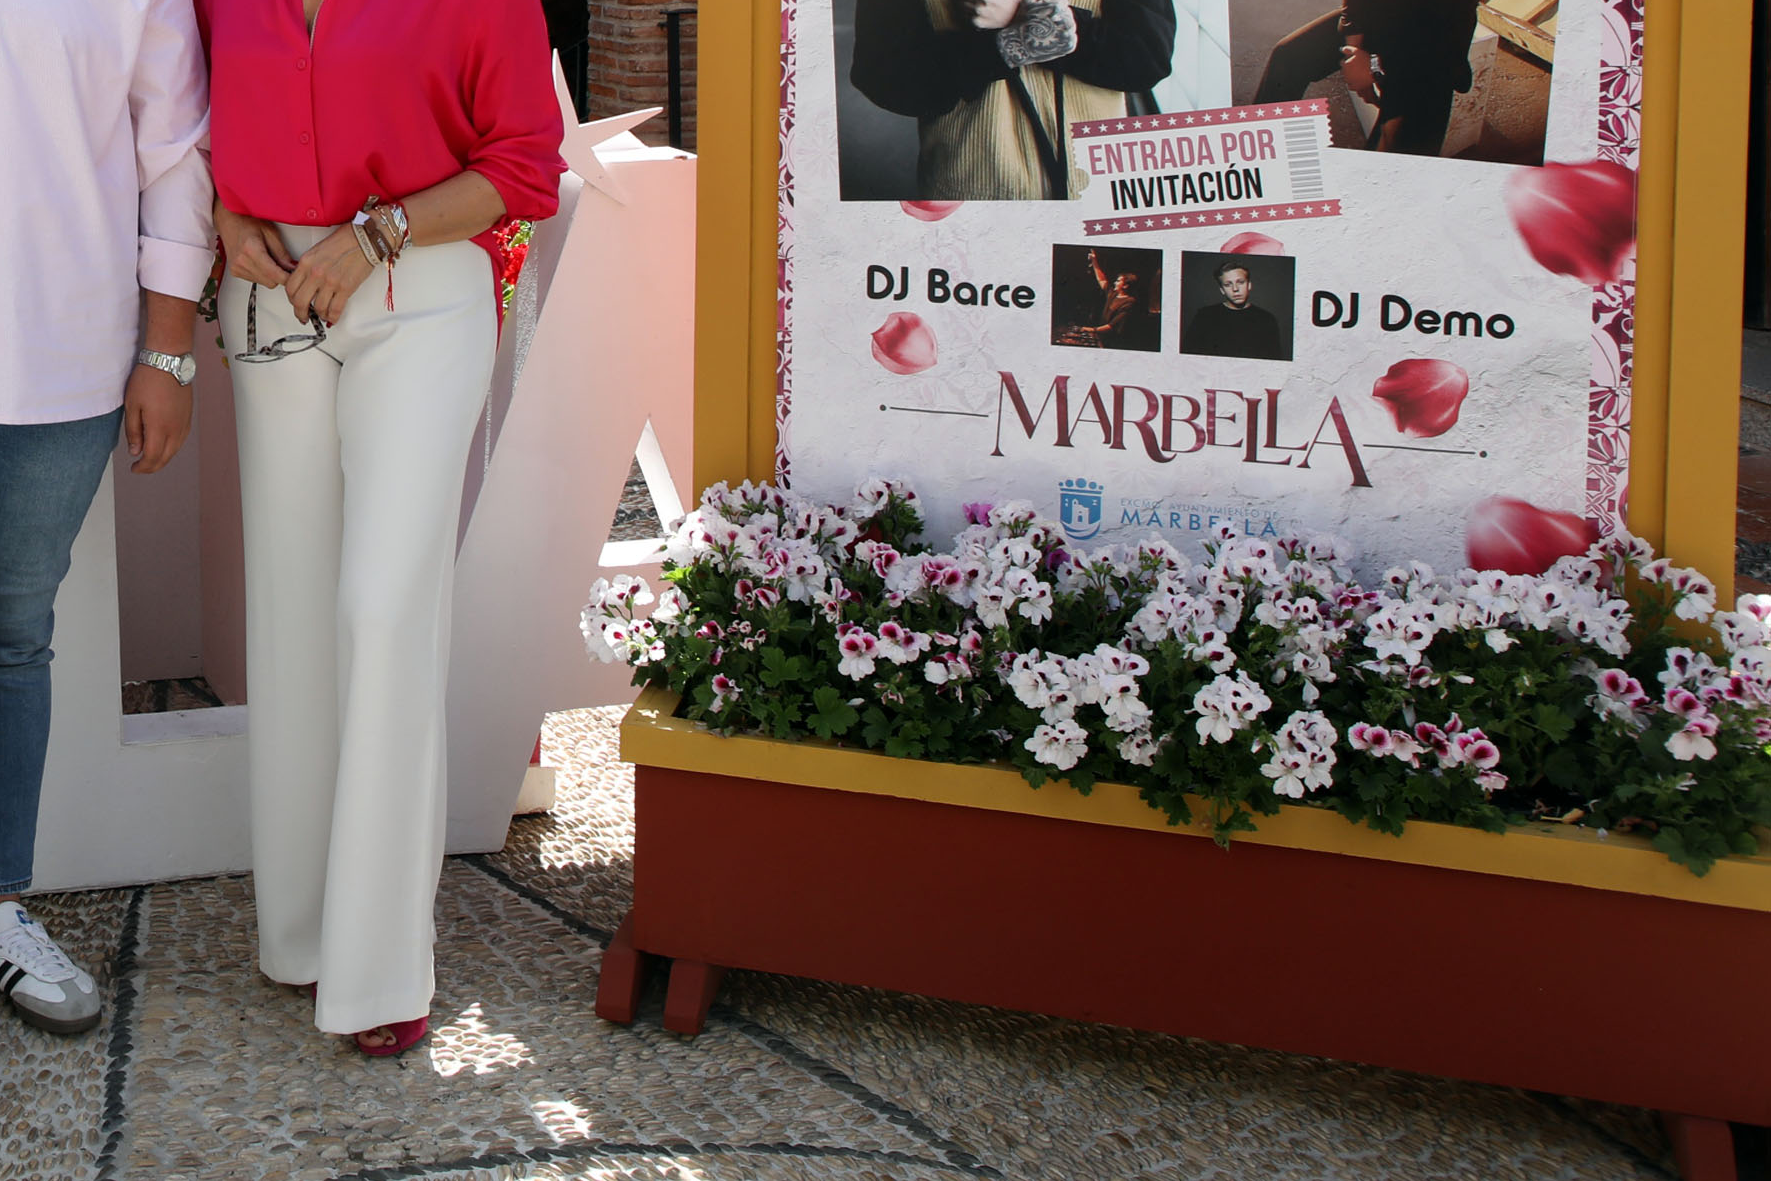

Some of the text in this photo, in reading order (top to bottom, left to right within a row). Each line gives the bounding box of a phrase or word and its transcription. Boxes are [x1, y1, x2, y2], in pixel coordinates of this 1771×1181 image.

[1088, 128, 1277, 177] ENTRADA POR
[1109, 162, 1264, 211] INVITACIÓN
[866, 264, 1036, 309] DJ Barce
[1311, 289, 1515, 340] DJ Demo
[990, 370, 1374, 488] MARBELLA
[1120, 508, 1278, 538] MARBELA
